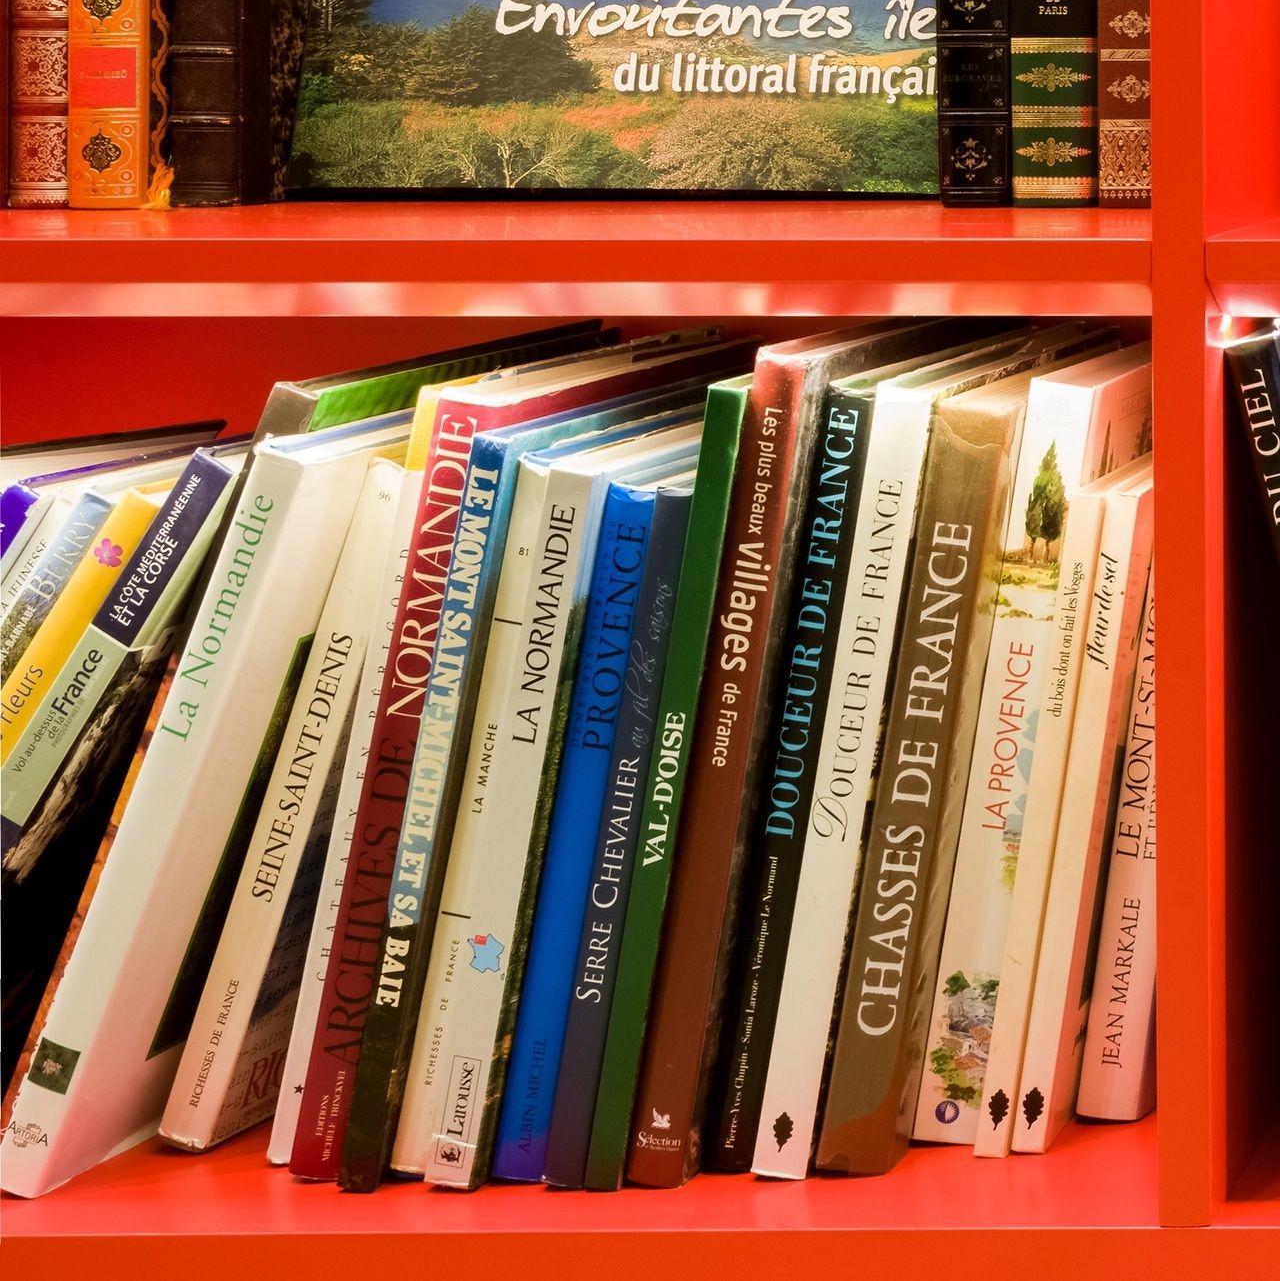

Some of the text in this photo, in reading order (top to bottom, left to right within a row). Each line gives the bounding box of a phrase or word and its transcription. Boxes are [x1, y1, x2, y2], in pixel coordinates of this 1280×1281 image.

[613, 53, 666, 94] du
[672, 53, 797, 95] littoral
[807, 53, 938, 105] françai
[1038, 6, 1068, 16] PARIS
[163, 490, 276, 742] La Normandie
[512, 502, 577, 745] LA NORMANDIE
[708, 406, 783, 769] Les plus beaux villages de France
[764, 405, 860, 839] DOUCEUR DE FRANCE
[251, 629, 358, 903] SEINE-SAINT-DENIS
[371, 464, 499, 1009] LE MONT SAINT-MICHEL ET SA BAIE
[643, 709, 688, 868] VAL-D'OISE
[856, 519, 974, 1039] CHASSES DE FRANCE
[575, 752, 644, 1004] SERRE CHEVALIER
